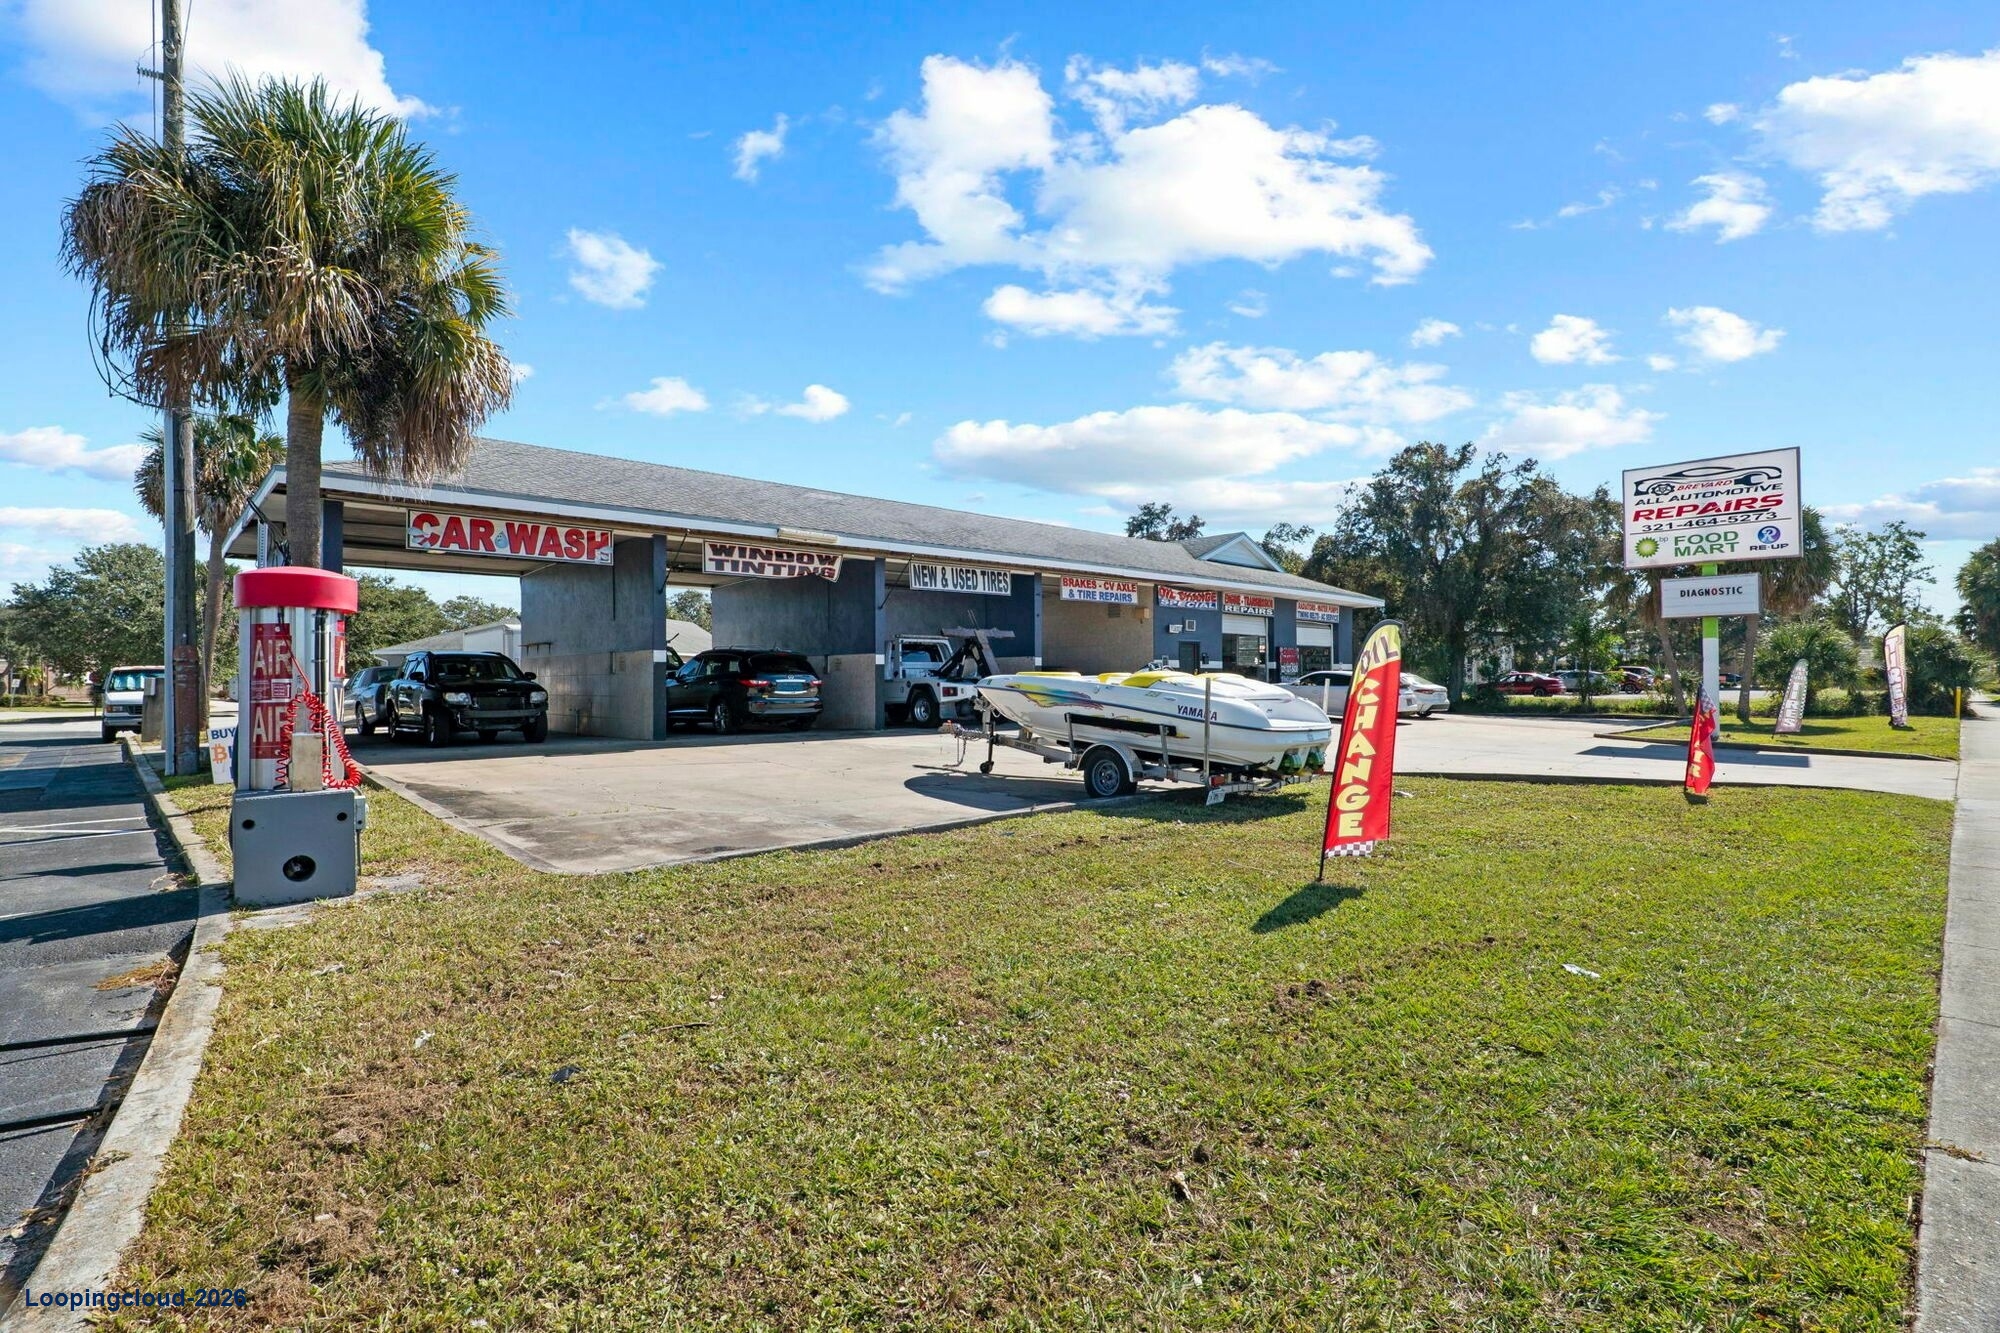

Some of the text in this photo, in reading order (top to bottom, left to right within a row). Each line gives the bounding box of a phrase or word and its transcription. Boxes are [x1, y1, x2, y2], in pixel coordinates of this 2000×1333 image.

[1677, 480, 1732, 491] BREVARD
[1635, 483, 1783, 506] ALL AUTOMOTIVE
[1642, 511, 1778, 532] 321-464-5273
[411, 513, 610, 560] CAR WASH
[1674, 531, 1739, 546] FOOD
[709, 543, 841, 566] WINDOW
[1674, 542, 1740, 557] MART
[913, 563, 1009, 593] NEW & USED TIRES
[1062, 576, 1097, 589] BRAKES
[1103, 582, 1115, 591] CV
[1117, 583, 1137, 593] AXLE
[1068, 588, 1133, 602] & TIRE REPAIRS
[1680, 586, 1743, 597] DIAGNOSTIC
[1160, 599, 1215, 608] SPECIAL
[1225, 605, 1273, 615] REPAIRS
[253, 639, 292, 676] AIR
[1359, 634, 1398, 675] OIL
[1177, 705, 1217, 721] YAMAA
[211, 728, 236, 740] BUY
[1336, 677, 1380, 838] CHANGE
